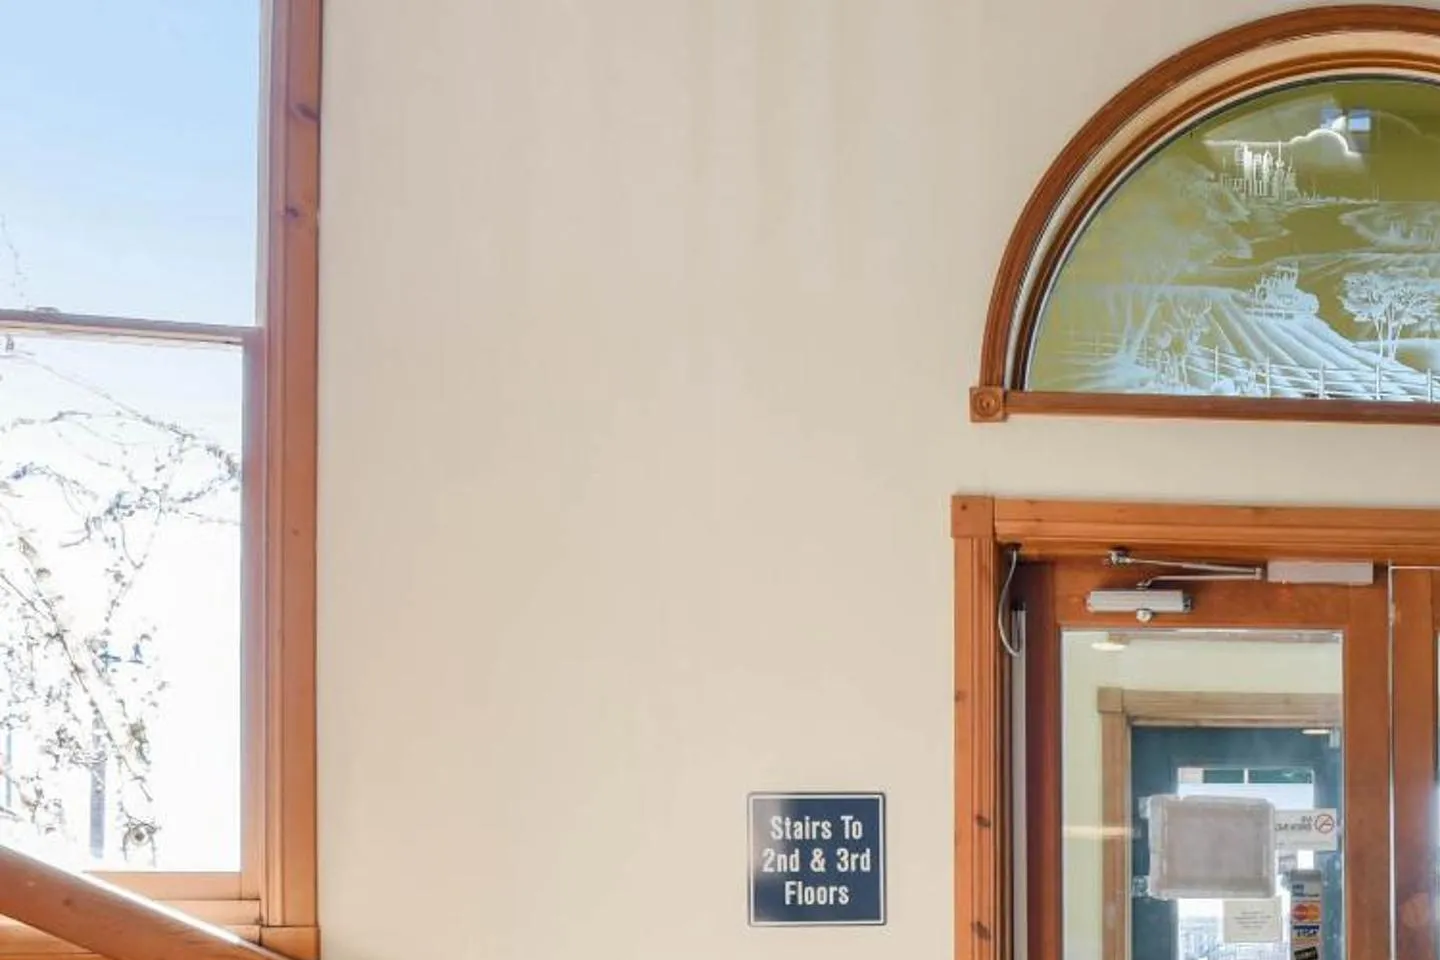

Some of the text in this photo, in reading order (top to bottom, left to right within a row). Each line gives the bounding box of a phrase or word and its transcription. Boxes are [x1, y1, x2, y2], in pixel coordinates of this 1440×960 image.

[770, 815, 863, 840] Stairs To
[762, 848, 871, 873] 2nd & 3rd
[784, 881, 850, 906] Floors
